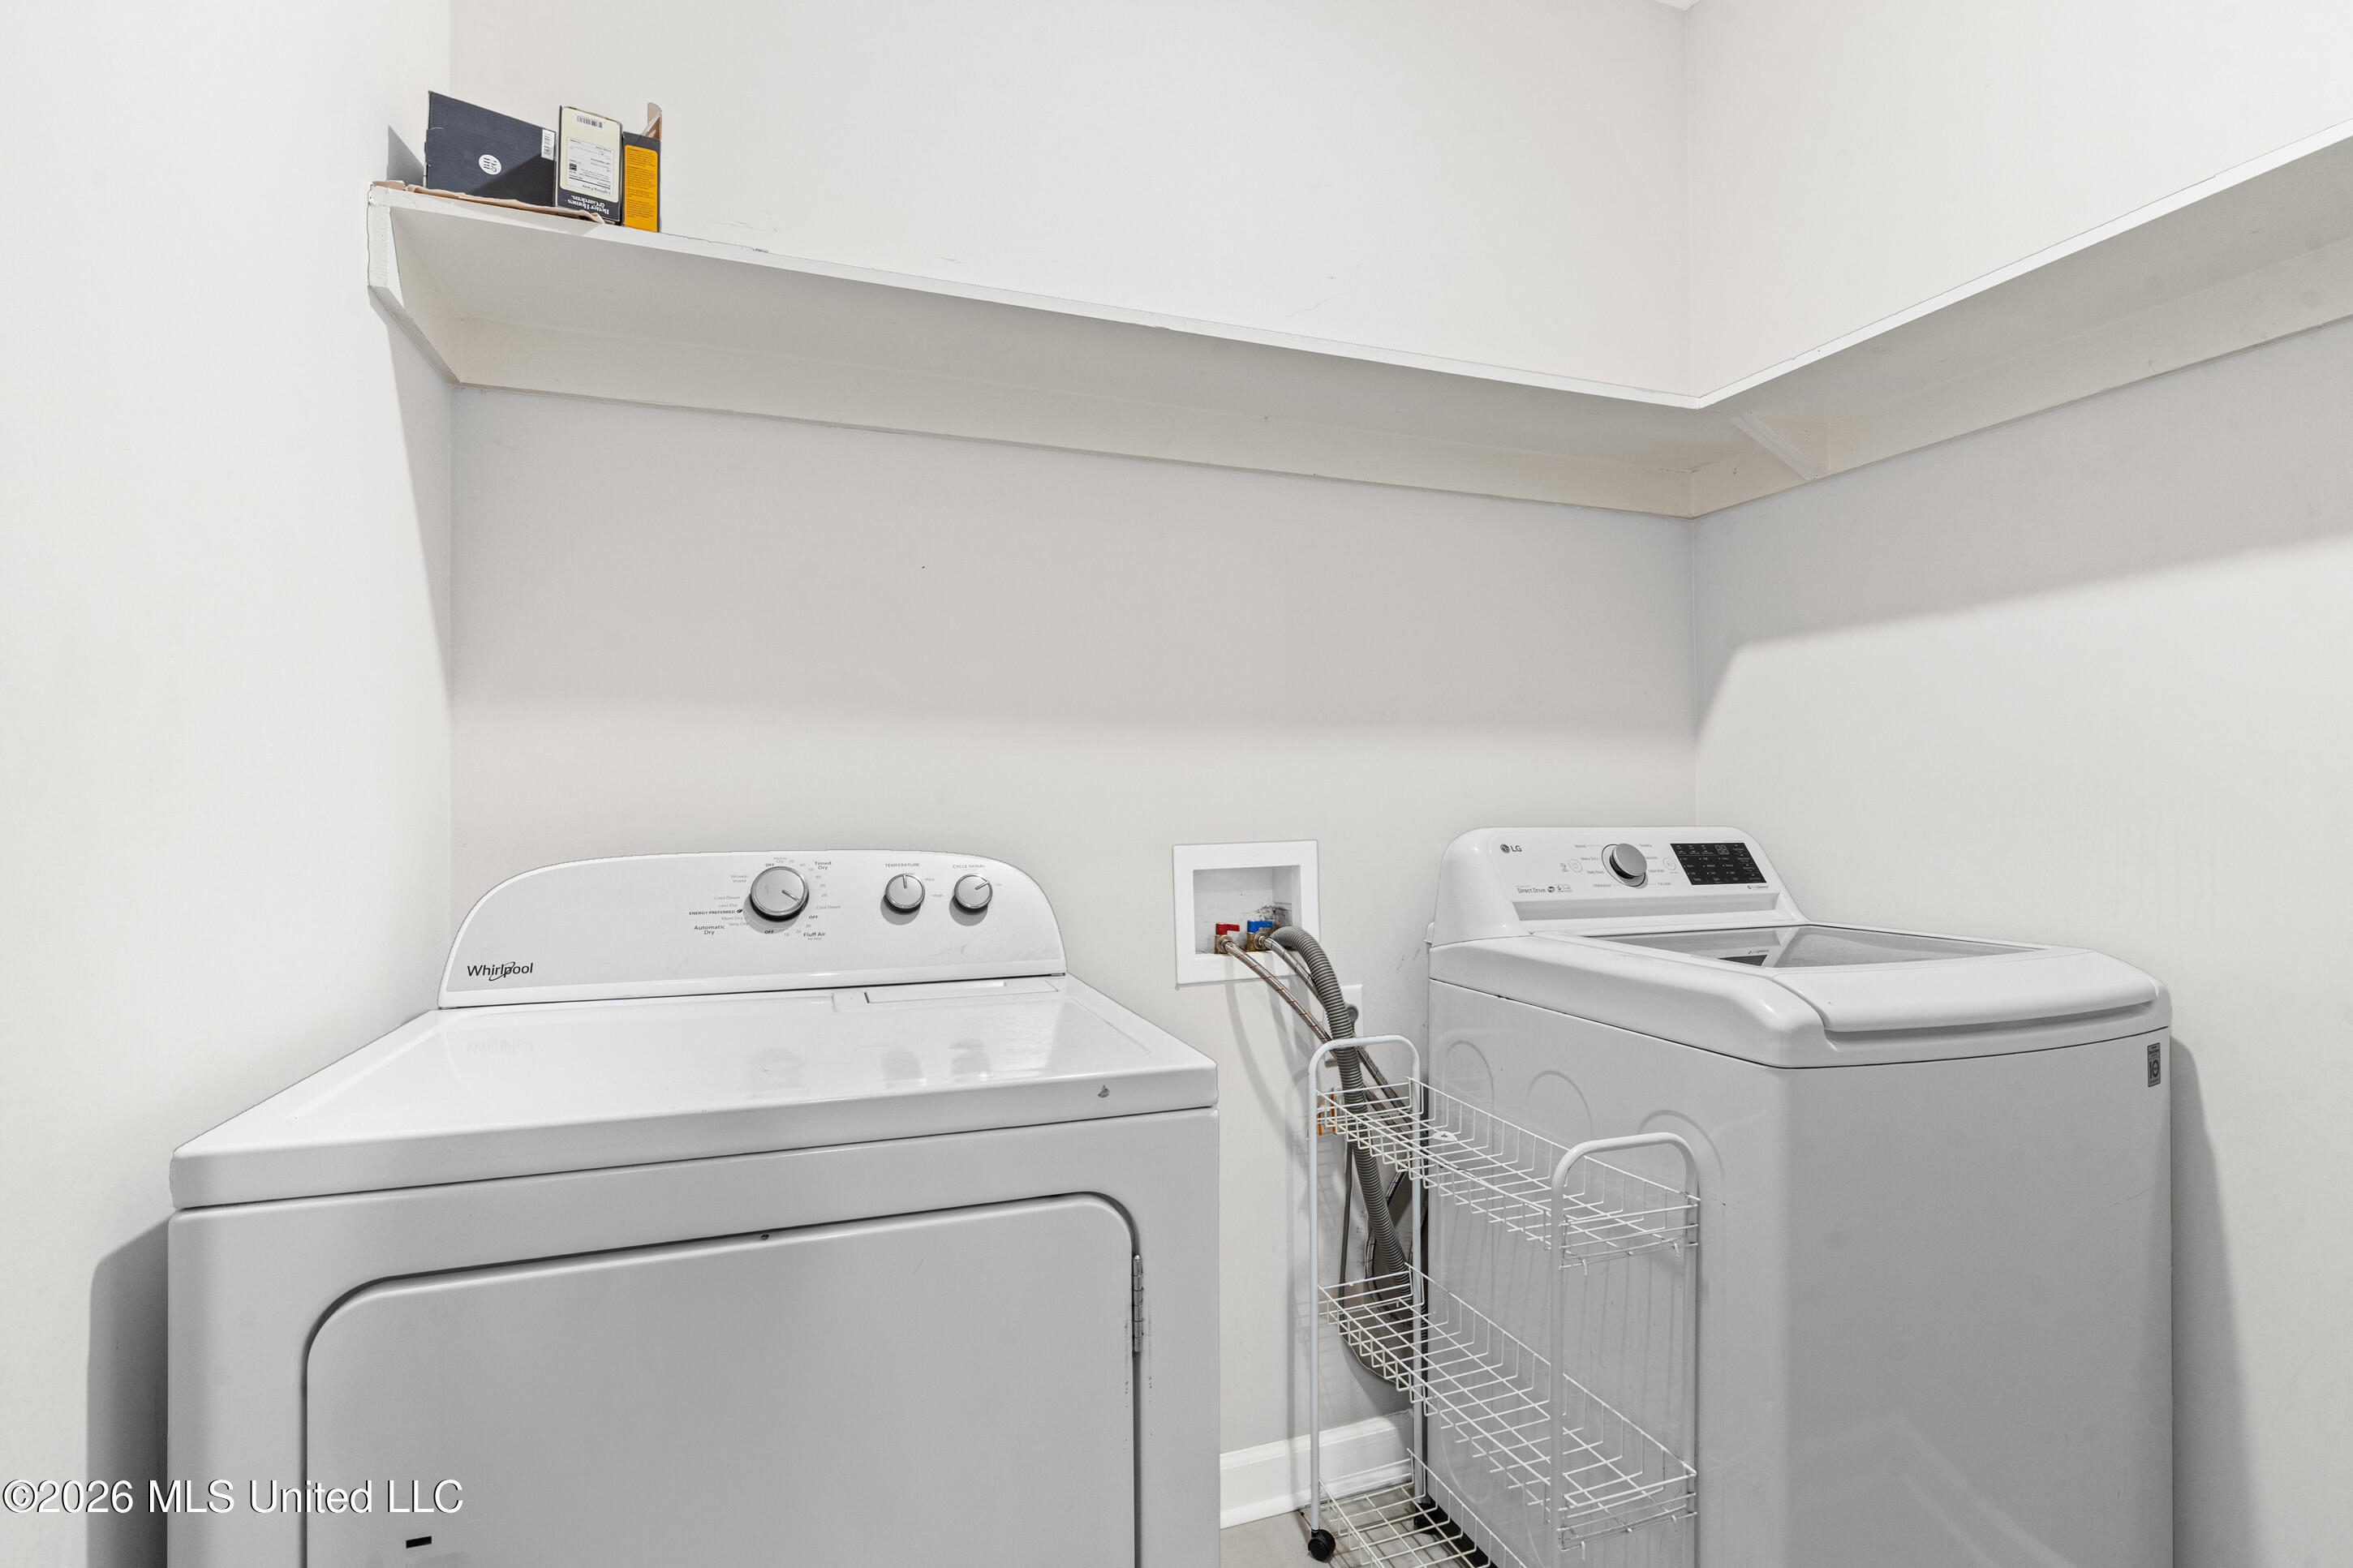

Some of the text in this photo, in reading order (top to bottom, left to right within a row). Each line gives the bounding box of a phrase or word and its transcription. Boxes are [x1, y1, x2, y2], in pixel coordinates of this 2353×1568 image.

[567, 199, 609, 215] Better Homes
[467, 962, 533, 980] Whirlpool
